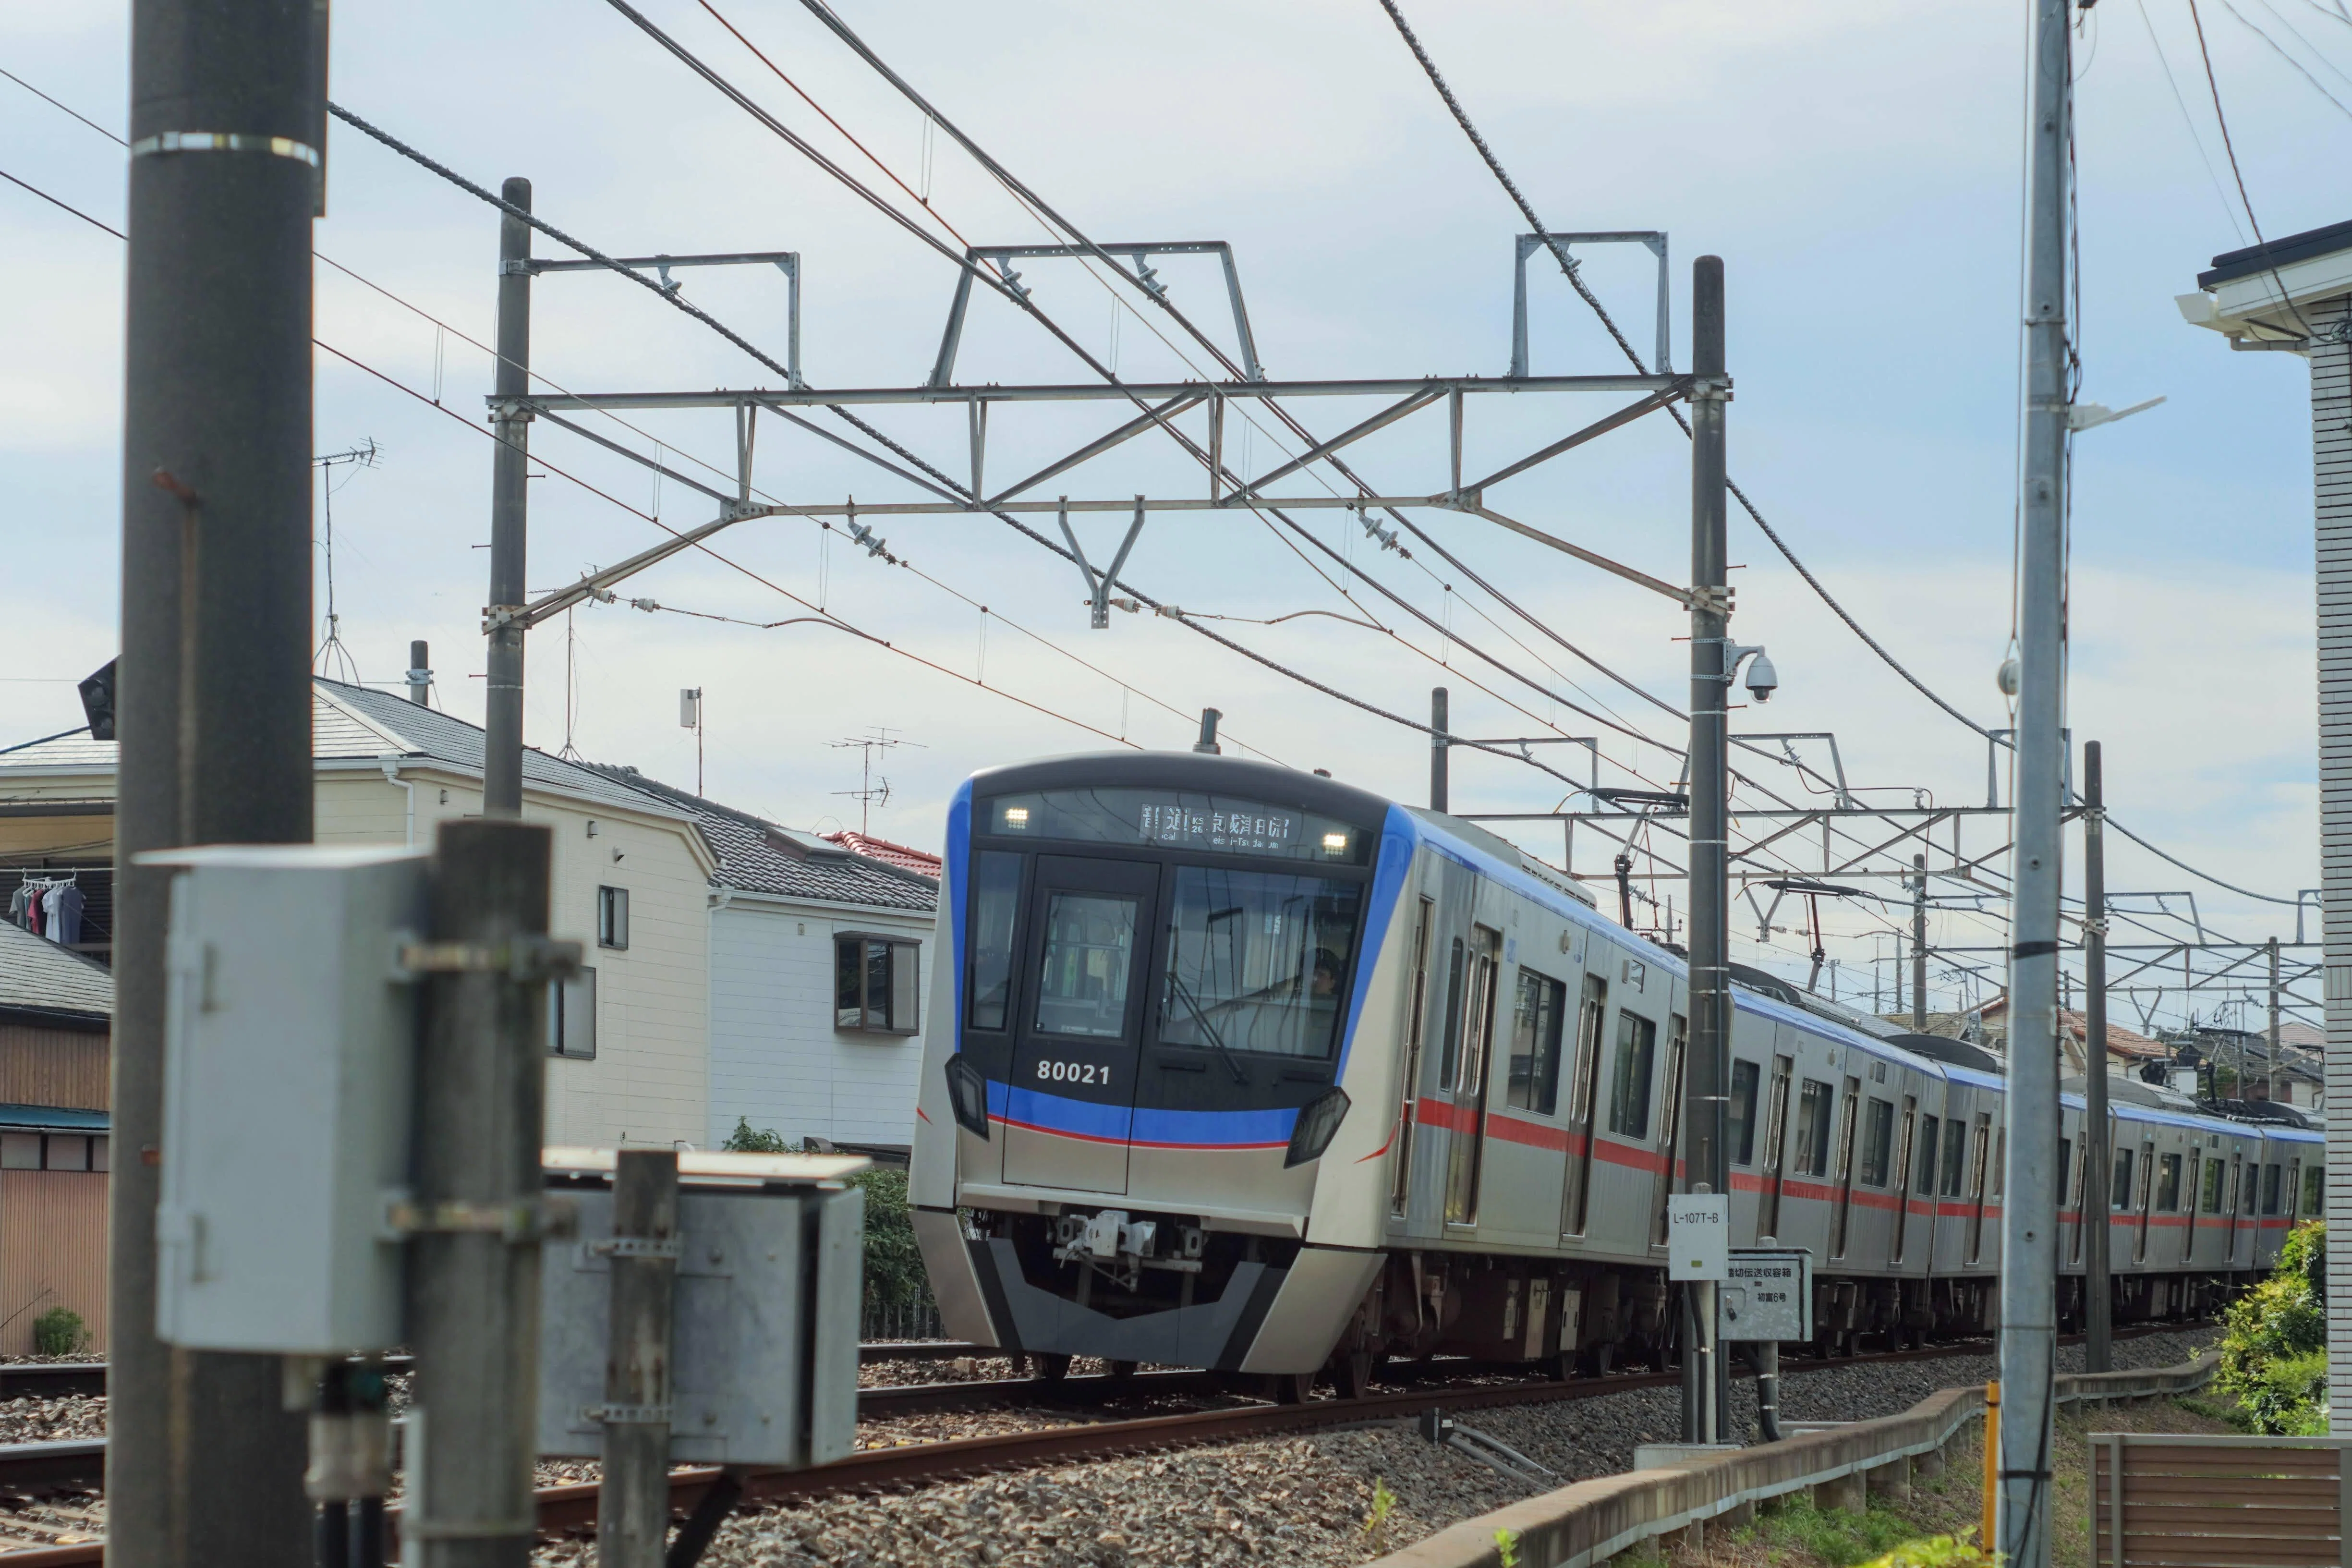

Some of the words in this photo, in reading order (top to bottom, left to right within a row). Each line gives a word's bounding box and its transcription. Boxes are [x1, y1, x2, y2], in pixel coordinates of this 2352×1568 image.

[1037, 1060, 1109, 1084] 80021
[1674, 1213, 1719, 1224] L-107T-B
[1758, 1292, 1787, 1302] 初富6号
